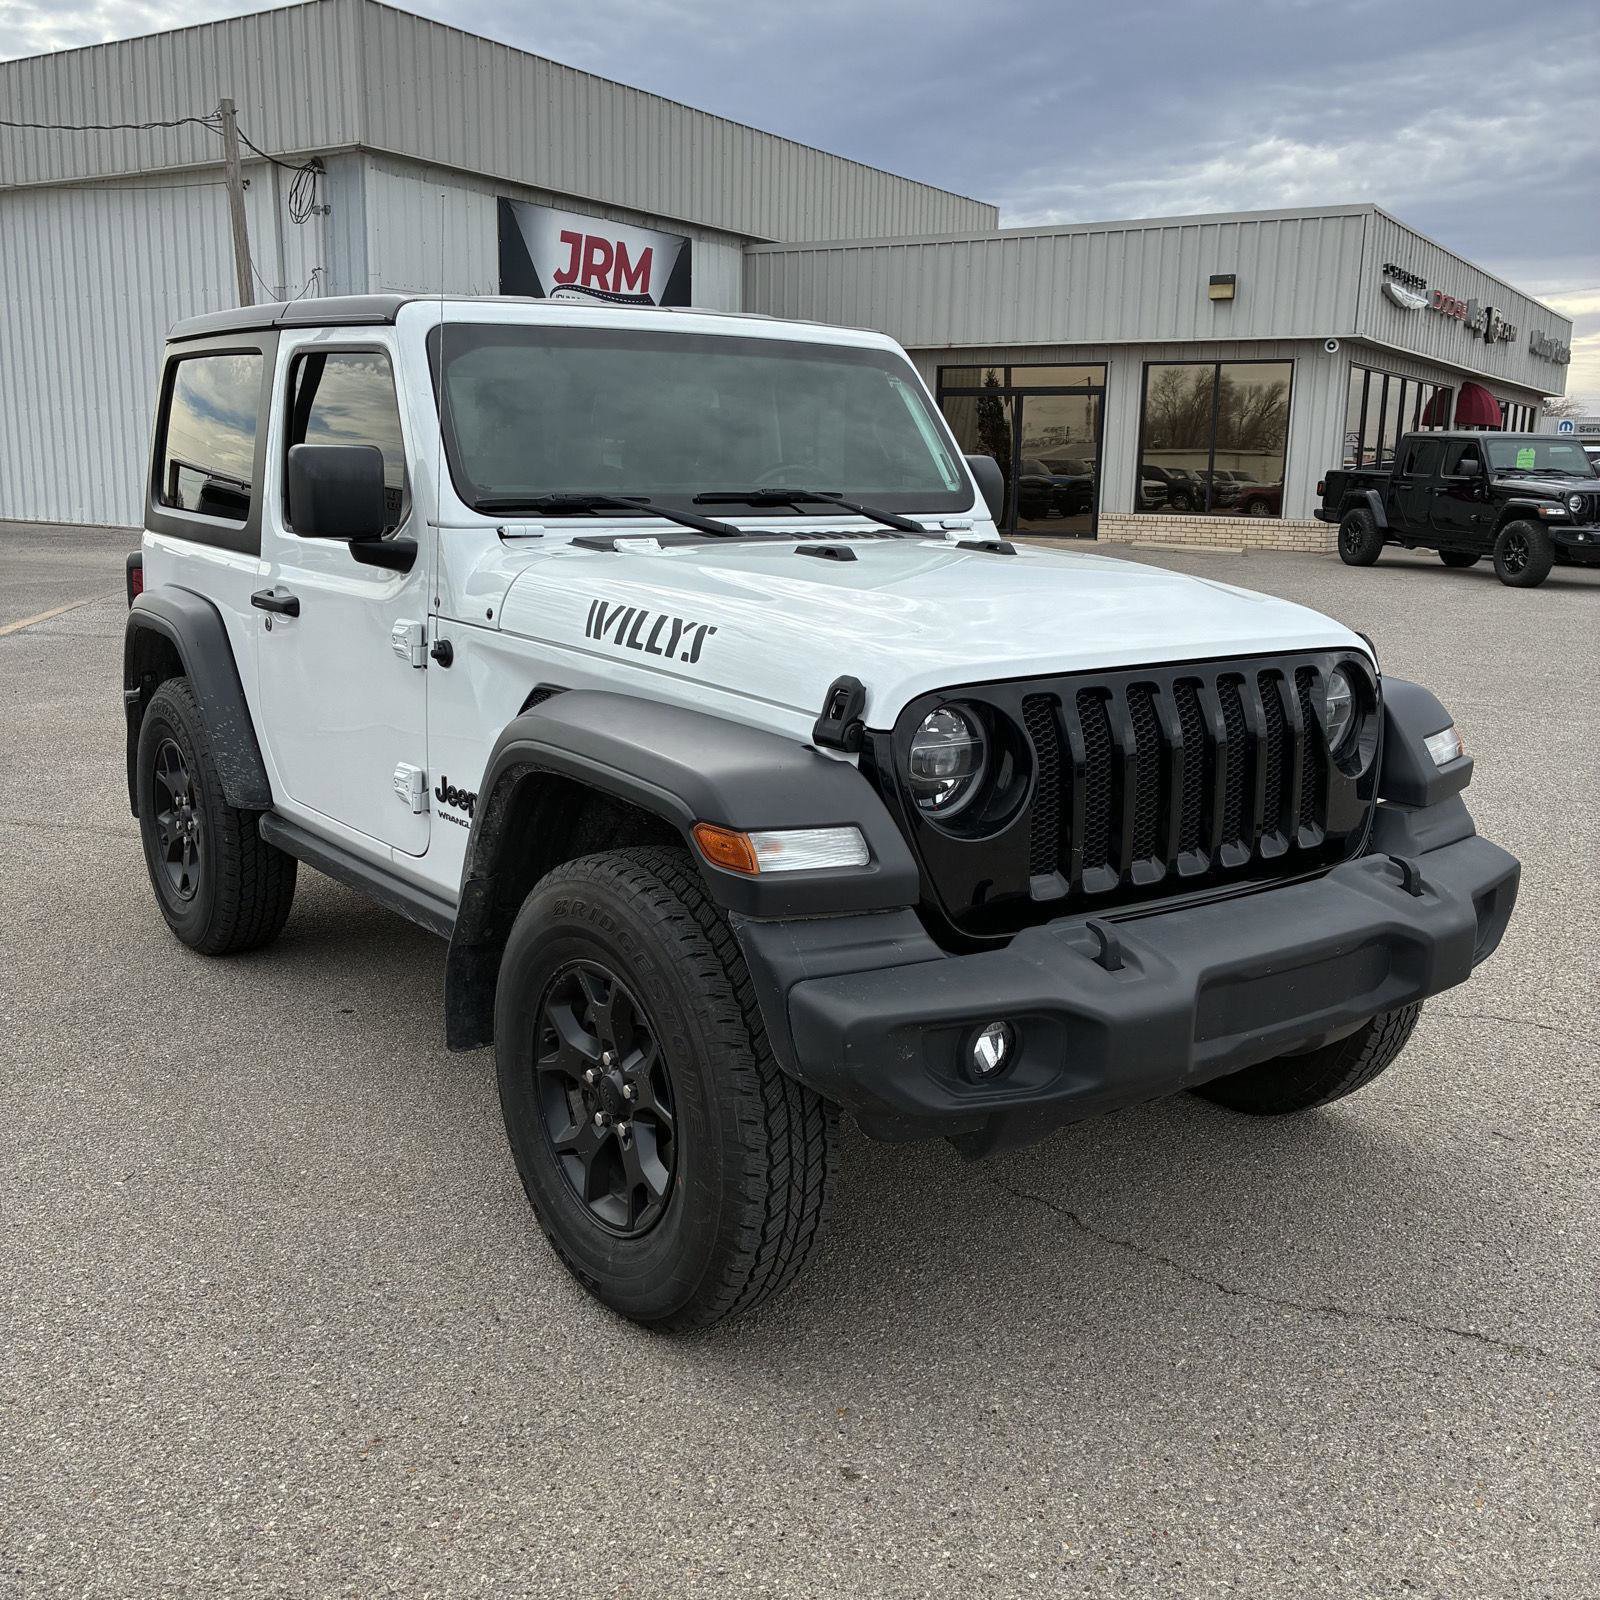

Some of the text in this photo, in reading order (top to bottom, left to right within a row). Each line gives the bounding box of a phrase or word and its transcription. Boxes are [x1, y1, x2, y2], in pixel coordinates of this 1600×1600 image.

[554, 230, 653, 292] JRM
[585, 599, 718, 664] WILLYS
[552, 897, 705, 1137] BRIDGESTONE
